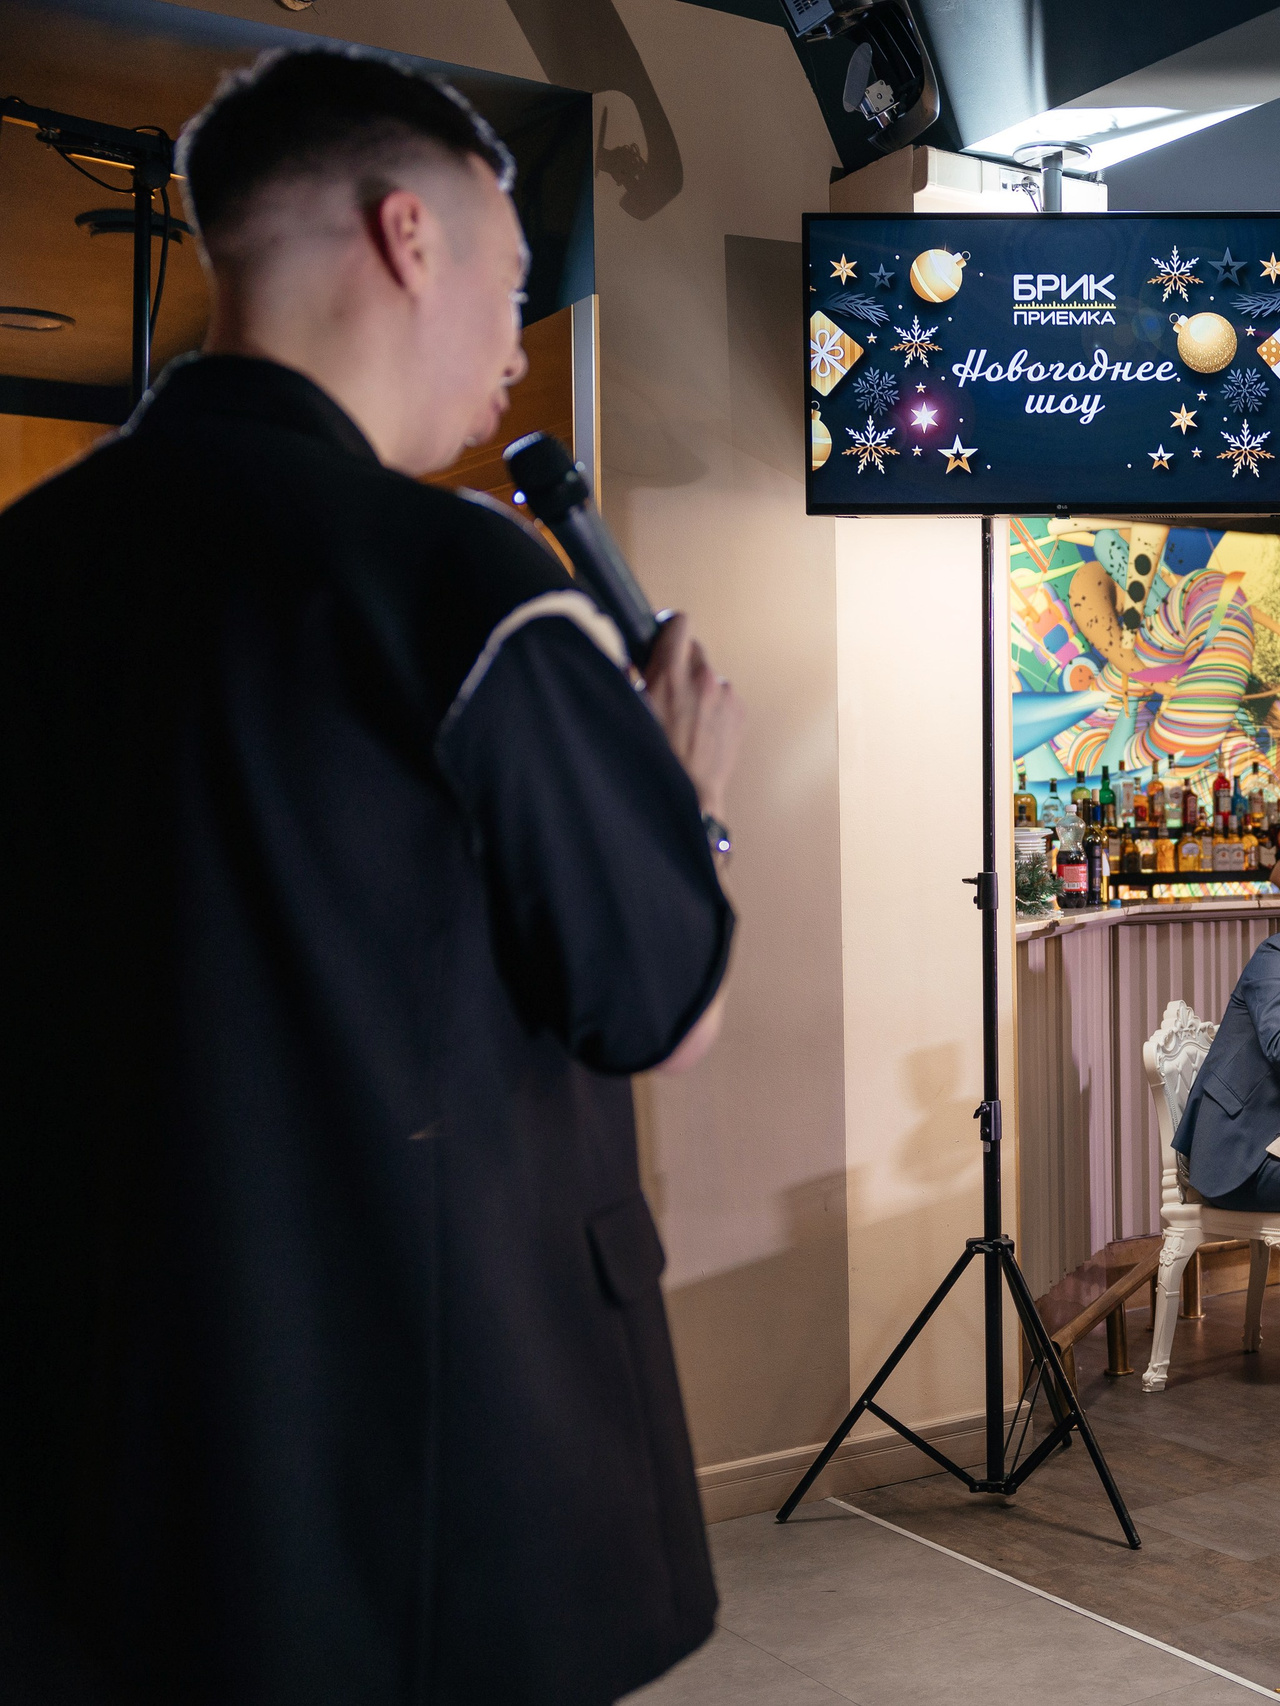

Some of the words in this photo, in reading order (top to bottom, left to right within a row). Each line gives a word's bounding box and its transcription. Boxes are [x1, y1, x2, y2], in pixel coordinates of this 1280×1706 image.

[1013, 274, 1116, 301] БРИК
[1013, 311, 1116, 325] ПРИЕМКА
[952, 348, 1177, 387] Новогоднее
[1025, 394, 1105, 424] шоу
